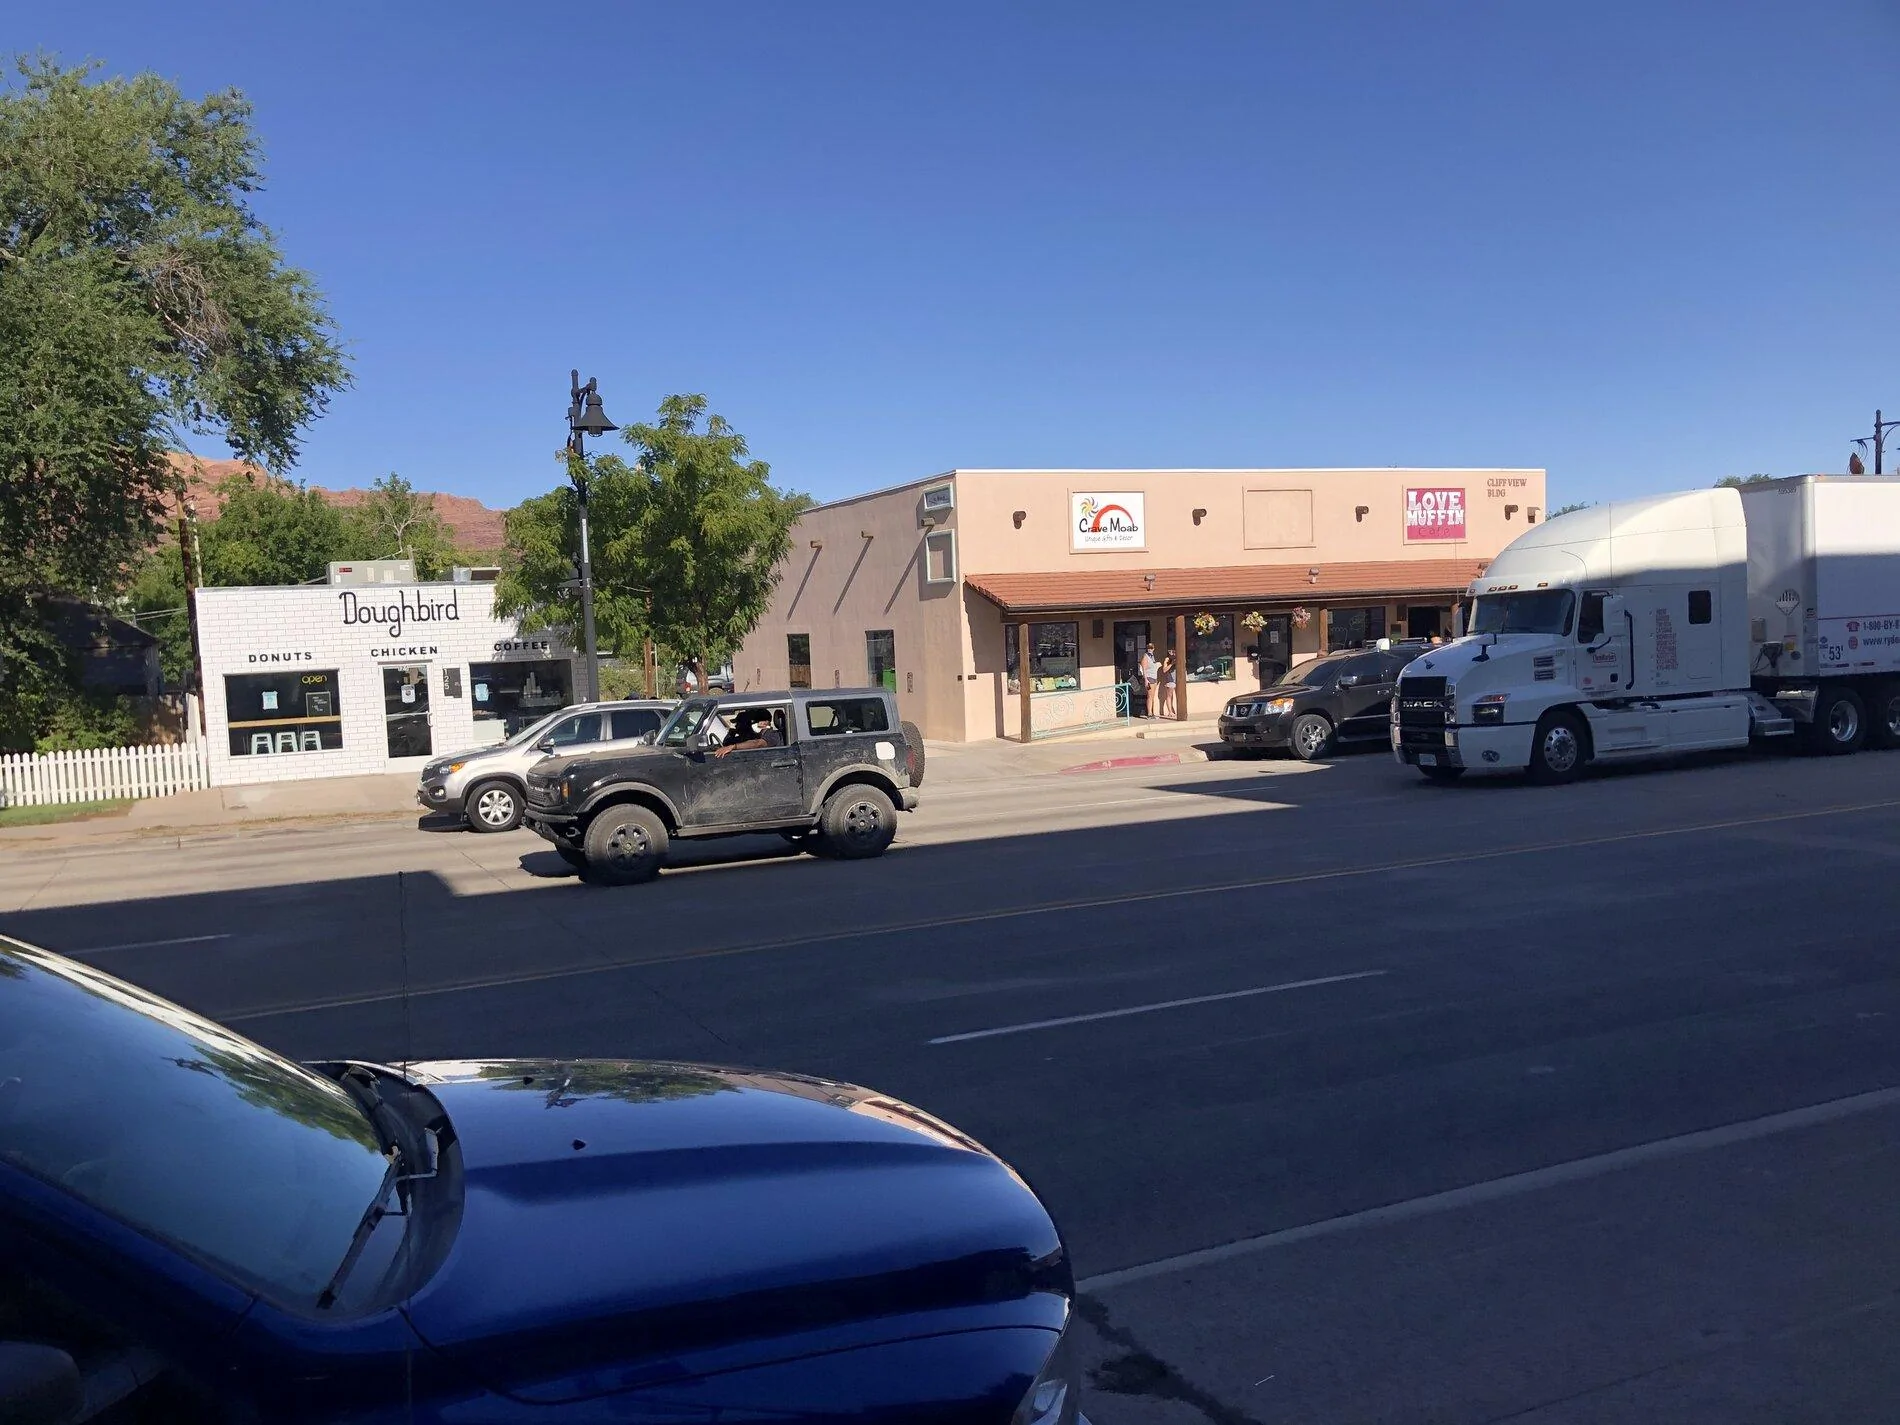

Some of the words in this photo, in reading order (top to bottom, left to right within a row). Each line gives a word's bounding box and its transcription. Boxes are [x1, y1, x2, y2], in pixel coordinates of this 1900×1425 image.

[1487, 479, 1506, 487] CLIFF
[1507, 479, 1527, 487] VIEW
[1487, 489, 1506, 497] BLDG
[1407, 491, 1462, 511] LOVE
[1406, 509, 1464, 526] MUFFIN
[1079, 518, 1108, 533] Crave
[1109, 517, 1139, 533] Moab
[339, 588, 459, 638] Doughbird
[370, 646, 438, 657] CHICKEN
[494, 641, 548, 652] COFFEE
[248, 651, 312, 663] DONUTS
[302, 674, 327, 685] open
[1403, 700, 1444, 708] MACK
